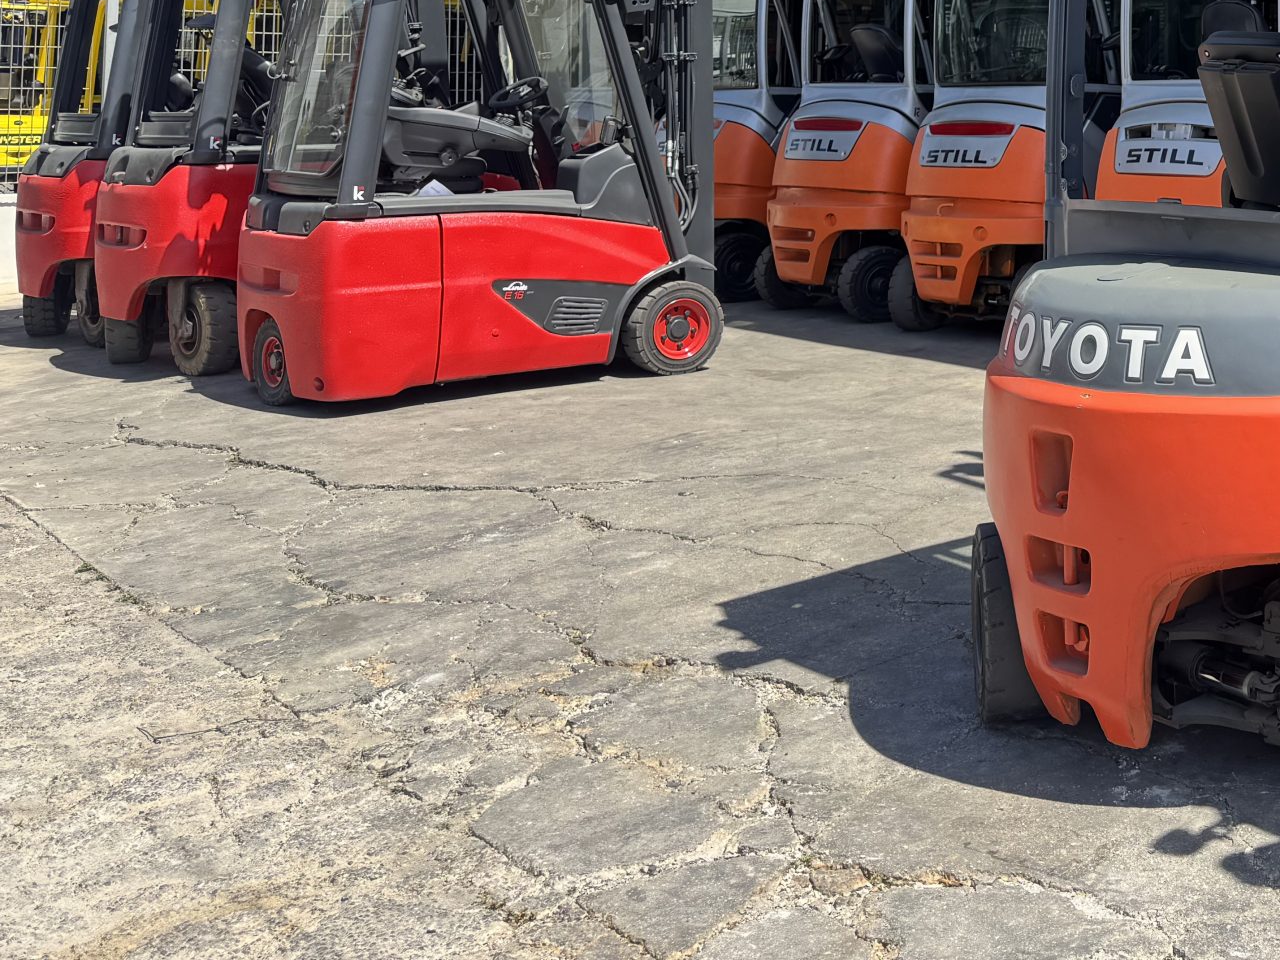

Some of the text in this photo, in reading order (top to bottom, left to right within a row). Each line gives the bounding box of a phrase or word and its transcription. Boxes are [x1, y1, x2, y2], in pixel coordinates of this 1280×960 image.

[789, 138, 839, 154] STILL
[925, 148, 988, 165] STILL
[1126, 147, 1204, 166] STILL
[1003, 305, 1213, 382] TOYOTA
